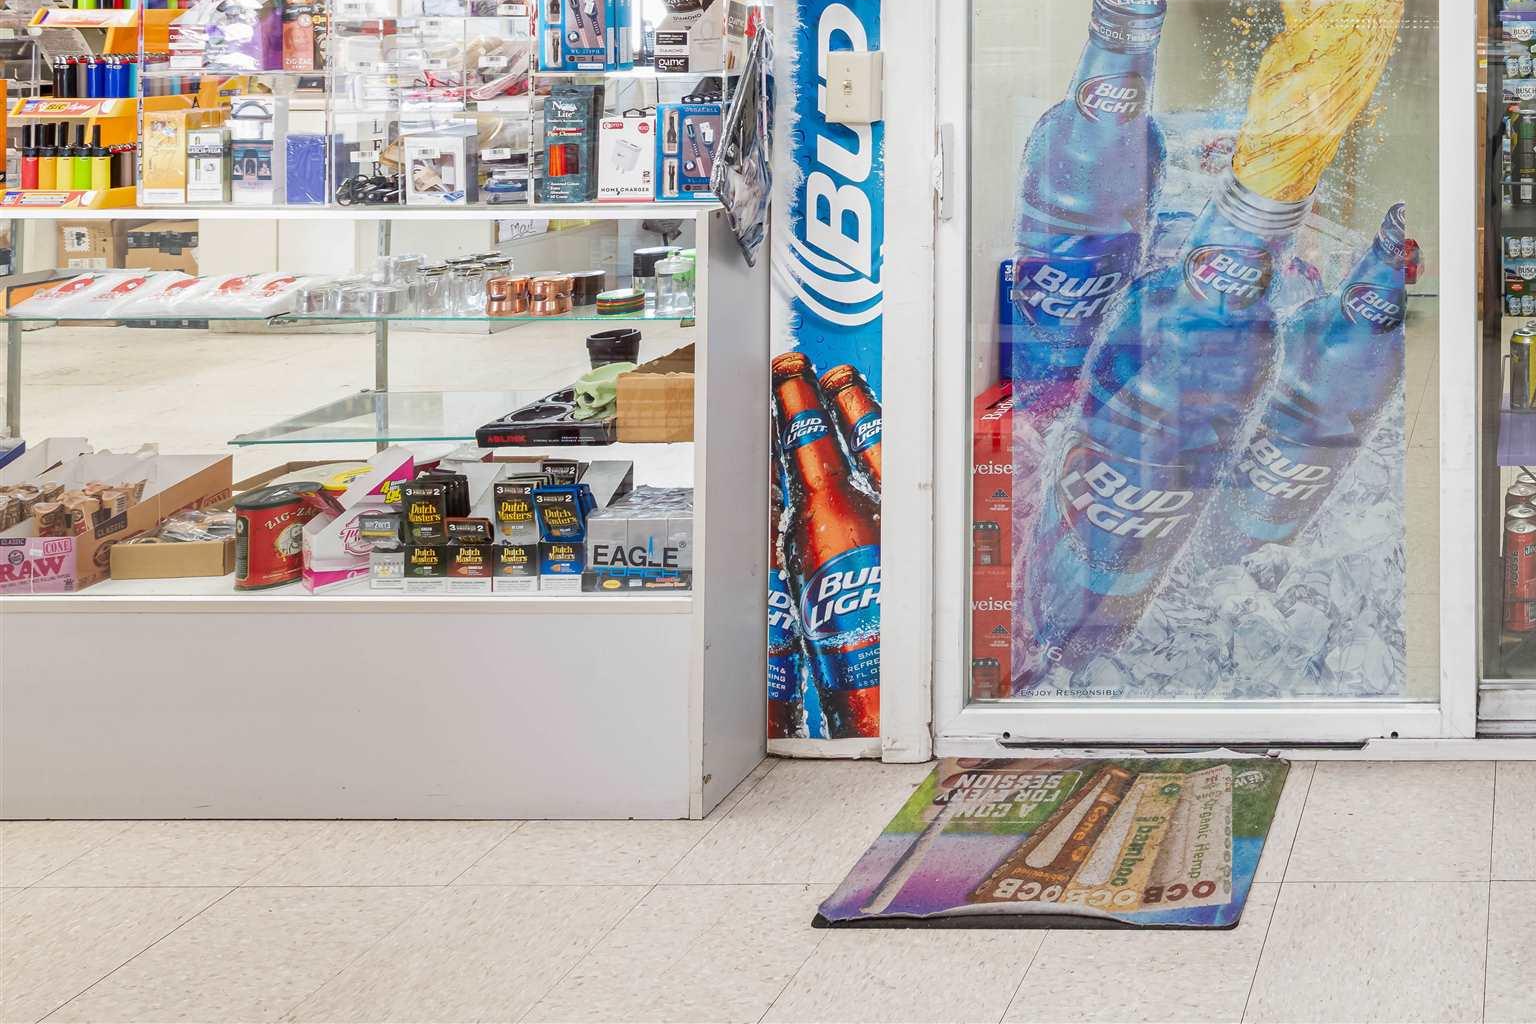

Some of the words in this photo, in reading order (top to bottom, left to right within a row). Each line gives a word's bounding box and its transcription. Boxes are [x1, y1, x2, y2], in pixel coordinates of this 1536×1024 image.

[1100, 26, 1125, 41] COOL
[658, 58, 686, 71] game
[1095, 83, 1138, 100] BUD
[1515, 87, 1536, 95] BUSCH
[1085, 94, 1141, 114] LIGHT
[1210, 253, 1264, 284] BUD
[1033, 264, 1123, 302] BUD
[1192, 262, 1266, 300] LIGHT
[1365, 289, 1400, 314] BUD
[1346, 295, 1399, 329] LIGHT
[786, 424, 828, 446] LIGHT
[790, 417, 823, 433] BUD
[856, 426, 882, 448] LIGH
[1252, 437, 1333, 482] BUD
[1086, 461, 1195, 515] BUD
[411, 503, 436, 515] Dutch
[502, 501, 528, 512] Dutch
[1060, 471, 1182, 539] LIGHT
[408, 511, 441, 523] Masters
[498, 510, 533, 522] Masters
[44, 539, 71, 556] CONE
[415, 548, 435, 557] Dutch
[459, 547, 480, 557] Dutch
[503, 547, 525, 557] Dutch
[551, 545, 573, 555] Dutch
[593, 534, 679, 568] EAGLE
[0, 555, 66, 584] RAW
[411, 555, 439, 564] Masters
[810, 588, 881, 632] LIGH
[954, 774, 1061, 791] SESSION
[1014, 789, 1061, 804] FOR
[1111, 821, 1151, 886] bamboo
[994, 877, 1063, 905] OCB
[1064, 887, 1139, 908] OCB
[1143, 879, 1216, 905] OCB
